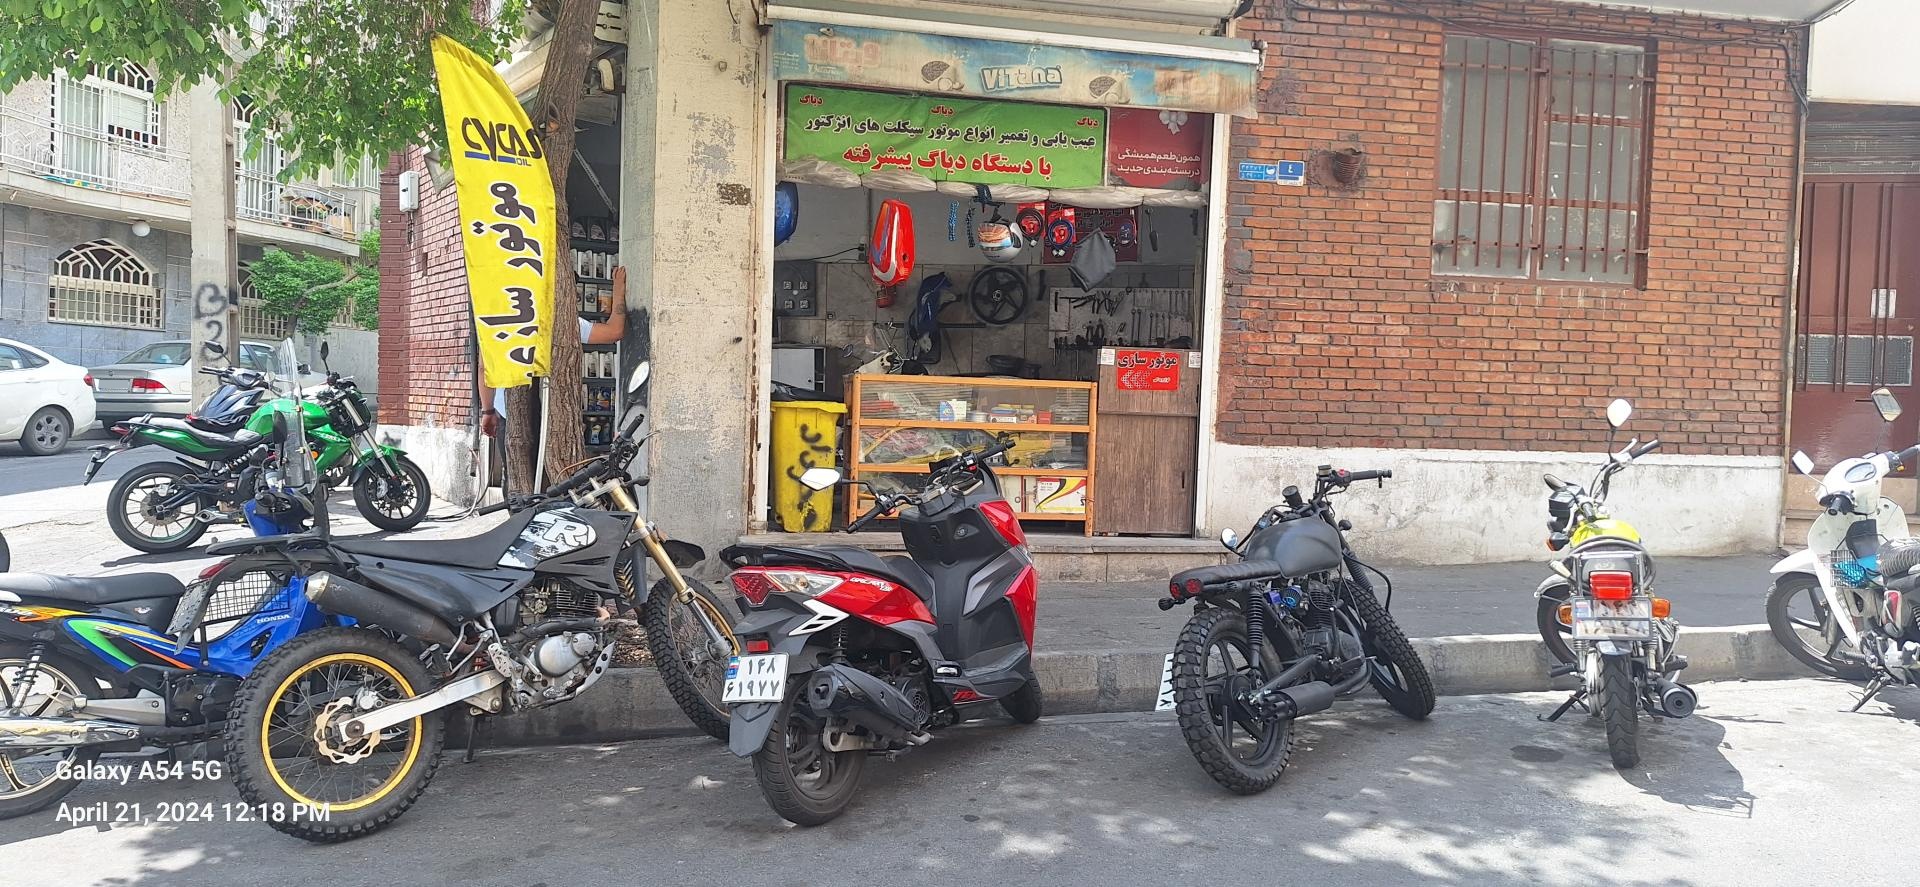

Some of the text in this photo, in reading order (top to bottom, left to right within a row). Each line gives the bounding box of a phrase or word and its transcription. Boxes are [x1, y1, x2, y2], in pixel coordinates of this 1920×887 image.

[804, 114, 1096, 150] عیب یابی و تعمیر انواع موتور سیکلت های انژکتور
[515, 157, 532, 167] OIL
[917, 149, 968, 174] دیاگ
[971, 152, 1034, 175] دستگاه
[1038, 156, 1053, 180] با
[473, 181, 544, 278] موتور
[1117, 351, 1147, 368] سازی
[1148, 352, 1178, 369] موتور
[256, 614, 290, 624] HONDA
[748, 657, 776, 675] ۱۴۸
[725, 680, 780, 698] ۶۱۹۷۷
